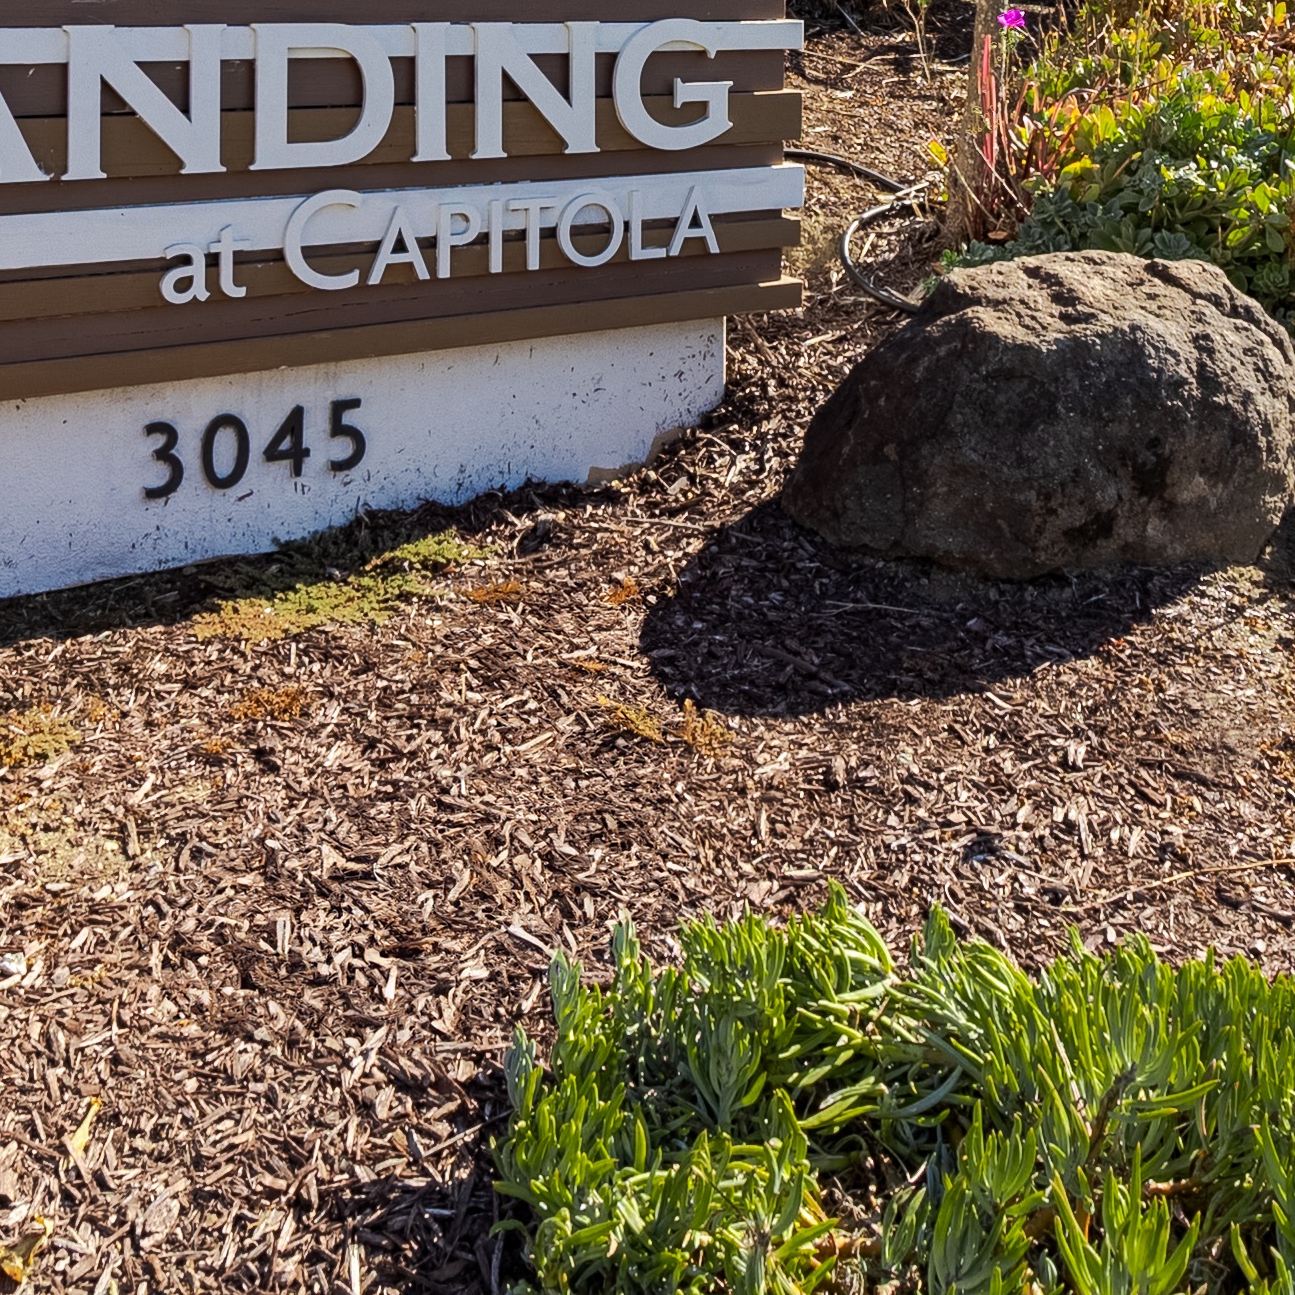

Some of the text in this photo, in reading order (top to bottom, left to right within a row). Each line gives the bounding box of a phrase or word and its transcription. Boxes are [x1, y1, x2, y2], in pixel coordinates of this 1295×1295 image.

[159, 185, 721, 304] at CAPITOLA
[143, 397, 368, 500] 3045
